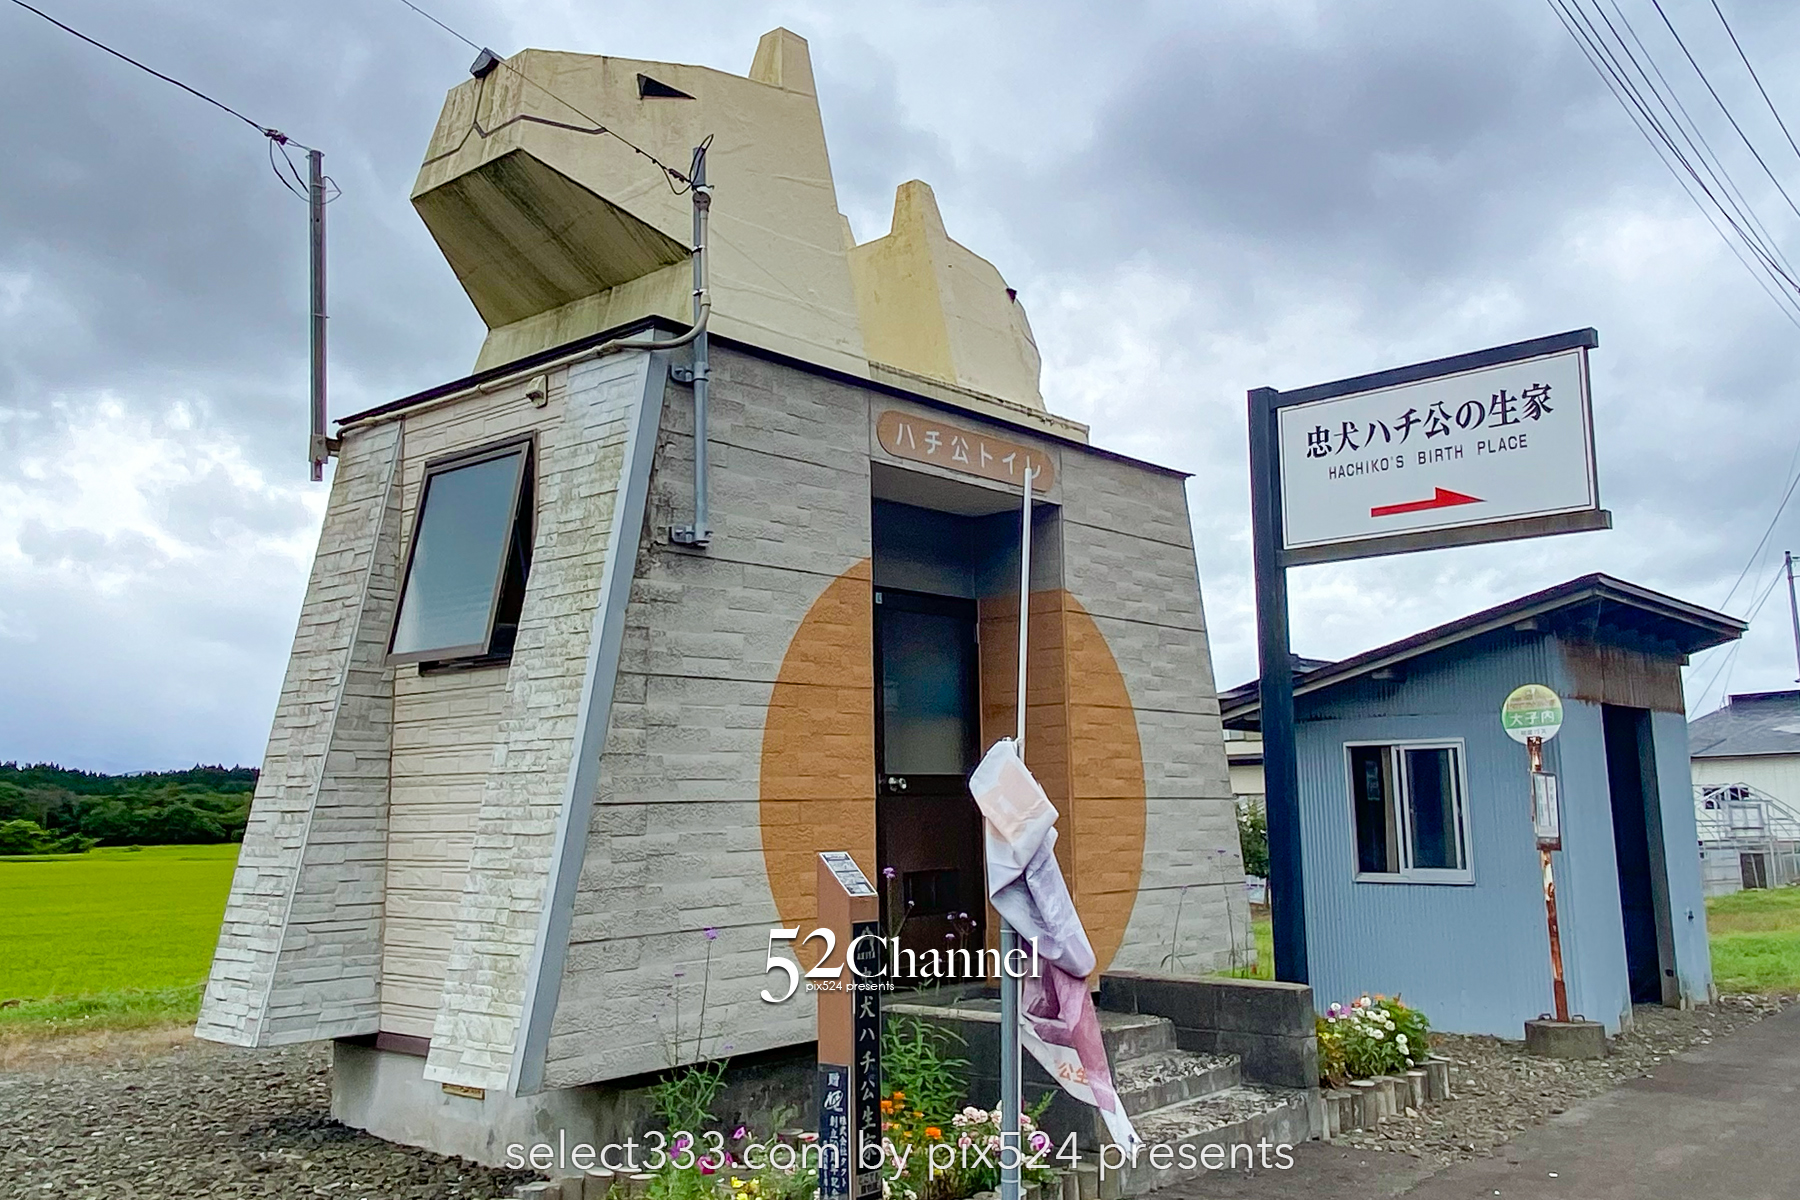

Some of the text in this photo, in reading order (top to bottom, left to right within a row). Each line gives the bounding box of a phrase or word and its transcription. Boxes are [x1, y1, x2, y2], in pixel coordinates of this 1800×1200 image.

[1306, 383, 1554, 459] 忠犬ハチ公の生家
[896, 423, 1041, 480] ハチ公トイレ
[1328, 434, 1528, 480] HACHIKO'S BIRTH PLACE
[1510, 710, 1555, 727] 大子内
